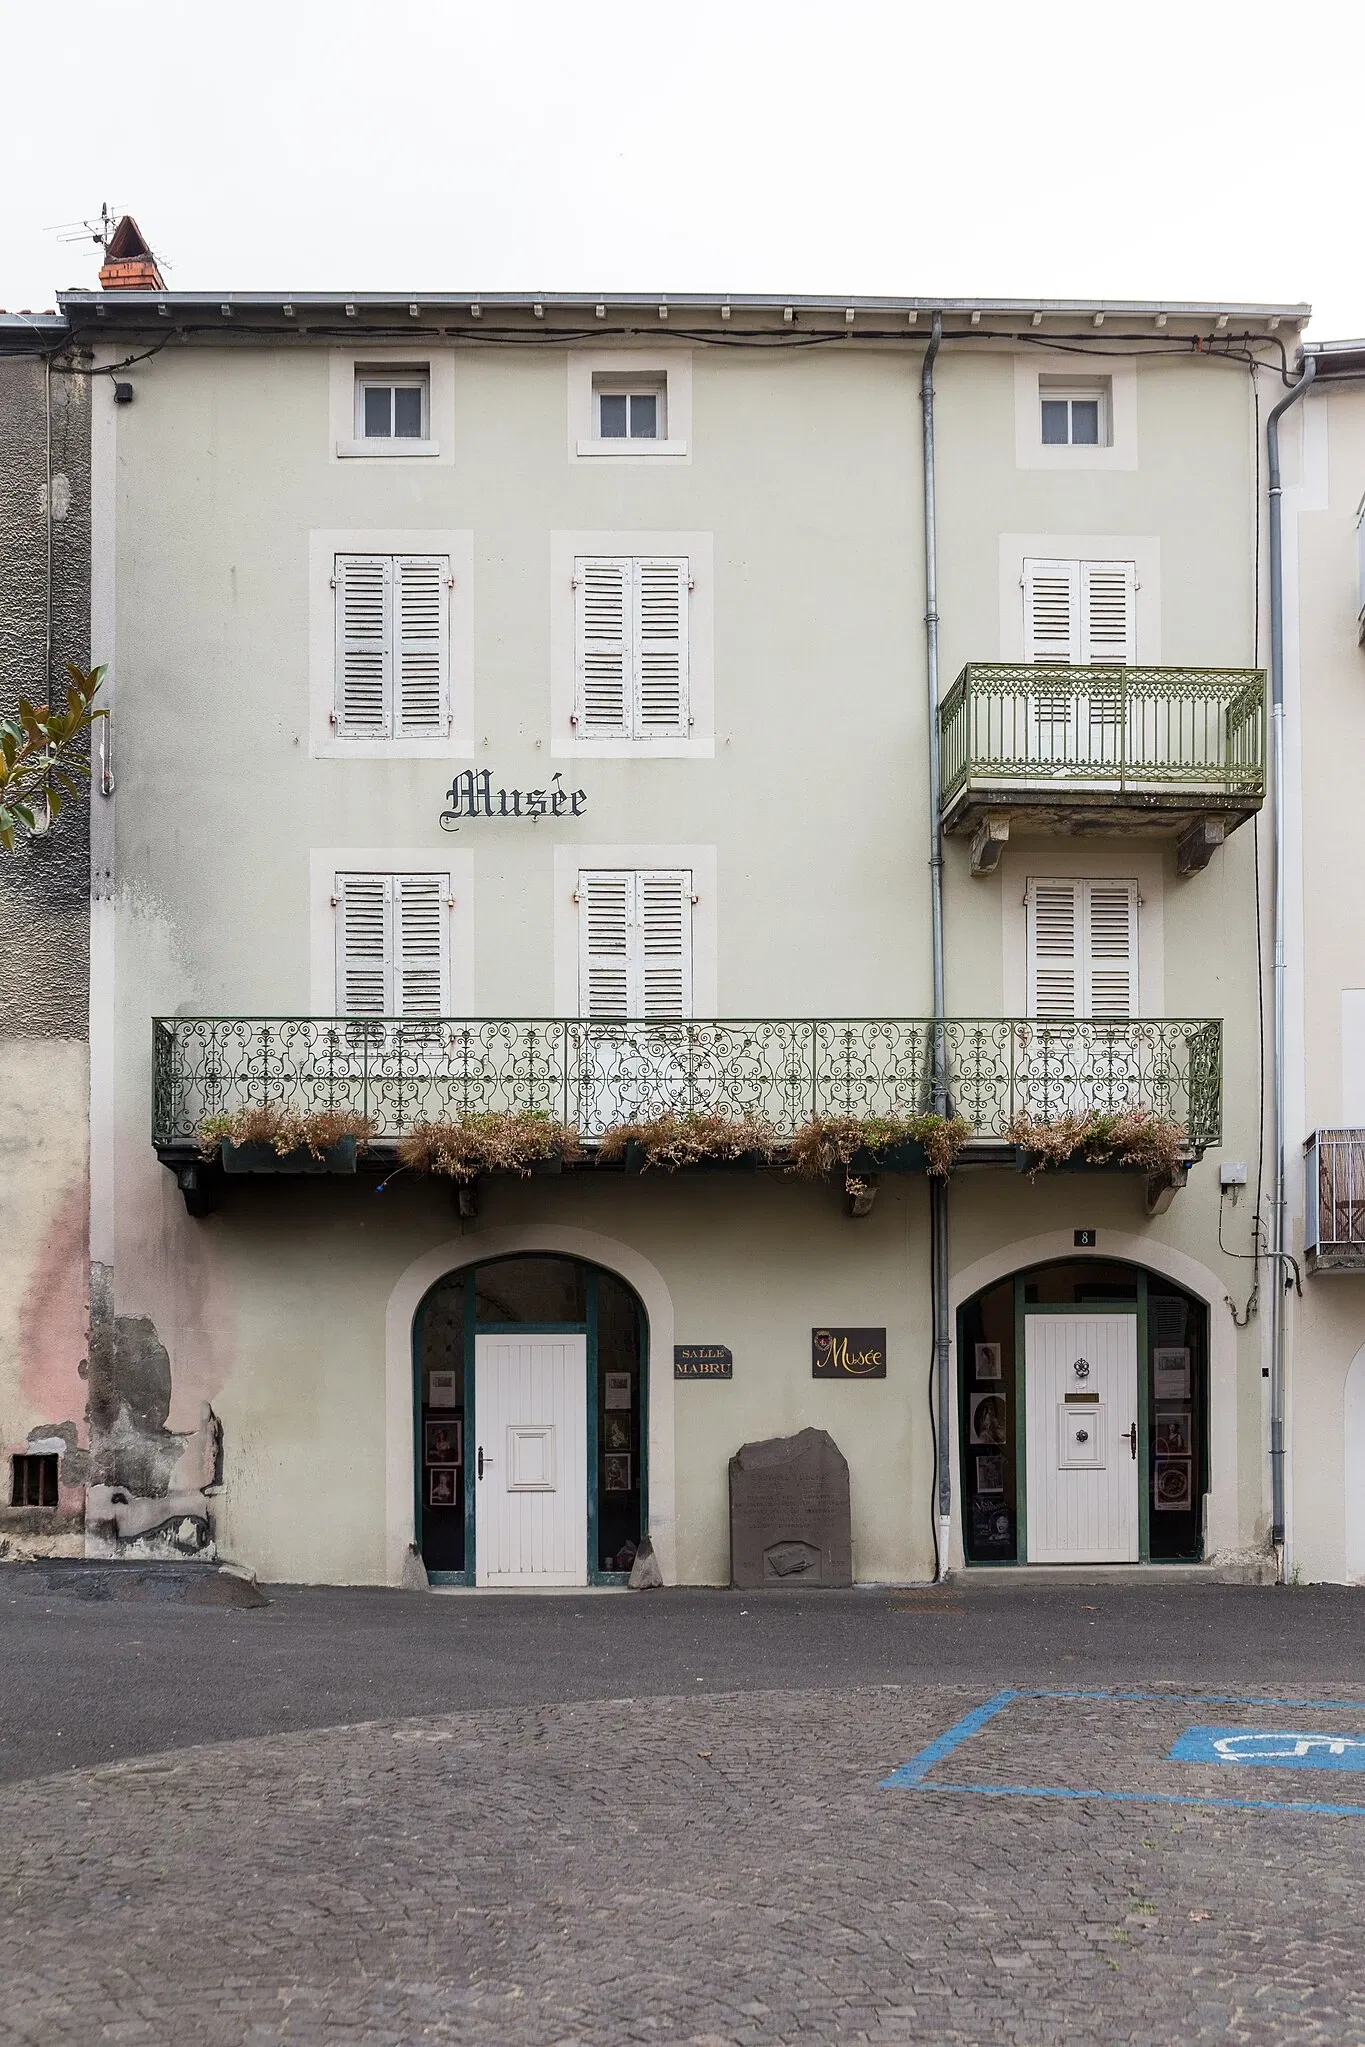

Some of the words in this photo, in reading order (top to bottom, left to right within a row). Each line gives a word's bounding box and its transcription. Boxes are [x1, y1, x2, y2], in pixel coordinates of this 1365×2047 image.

[439, 769, 588, 832] Musée
[1081, 1232, 1089, 1244] 8
[682, 1350, 725, 1358] SALLE
[817, 1337, 882, 1374] Musée
[676, 1363, 731, 1374] MABRU
